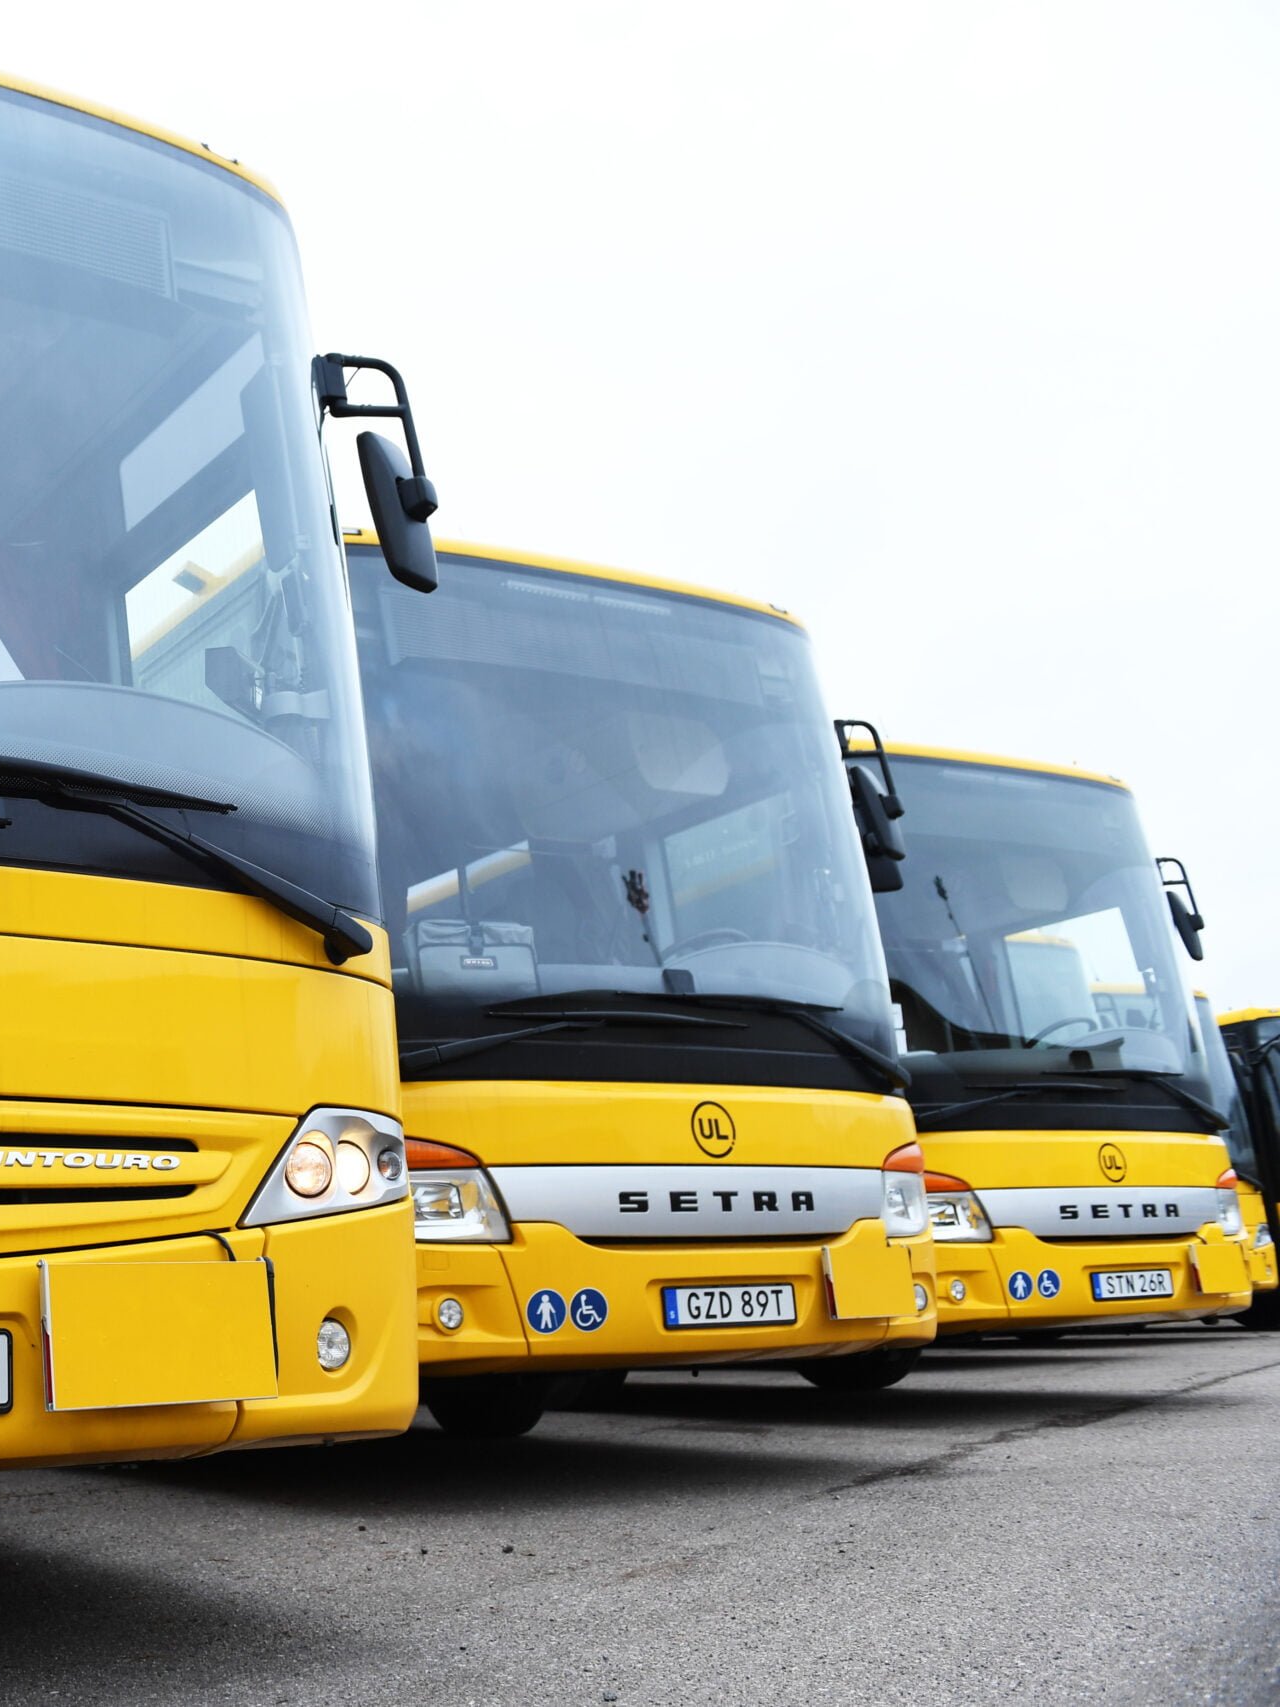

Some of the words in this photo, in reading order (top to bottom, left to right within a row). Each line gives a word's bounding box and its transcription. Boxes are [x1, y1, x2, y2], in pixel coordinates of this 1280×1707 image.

[699, 1118, 729, 1140] UL
[1102, 1155, 1123, 1170] UL
[619, 1191, 814, 1213] SETRA
[1059, 1204, 1180, 1220] SETRA
[1106, 1274, 1135, 1294] STN
[1139, 1273, 1166, 1293] 26R
[687, 1291, 733, 1320] GZD
[741, 1289, 784, 1317] 89T
